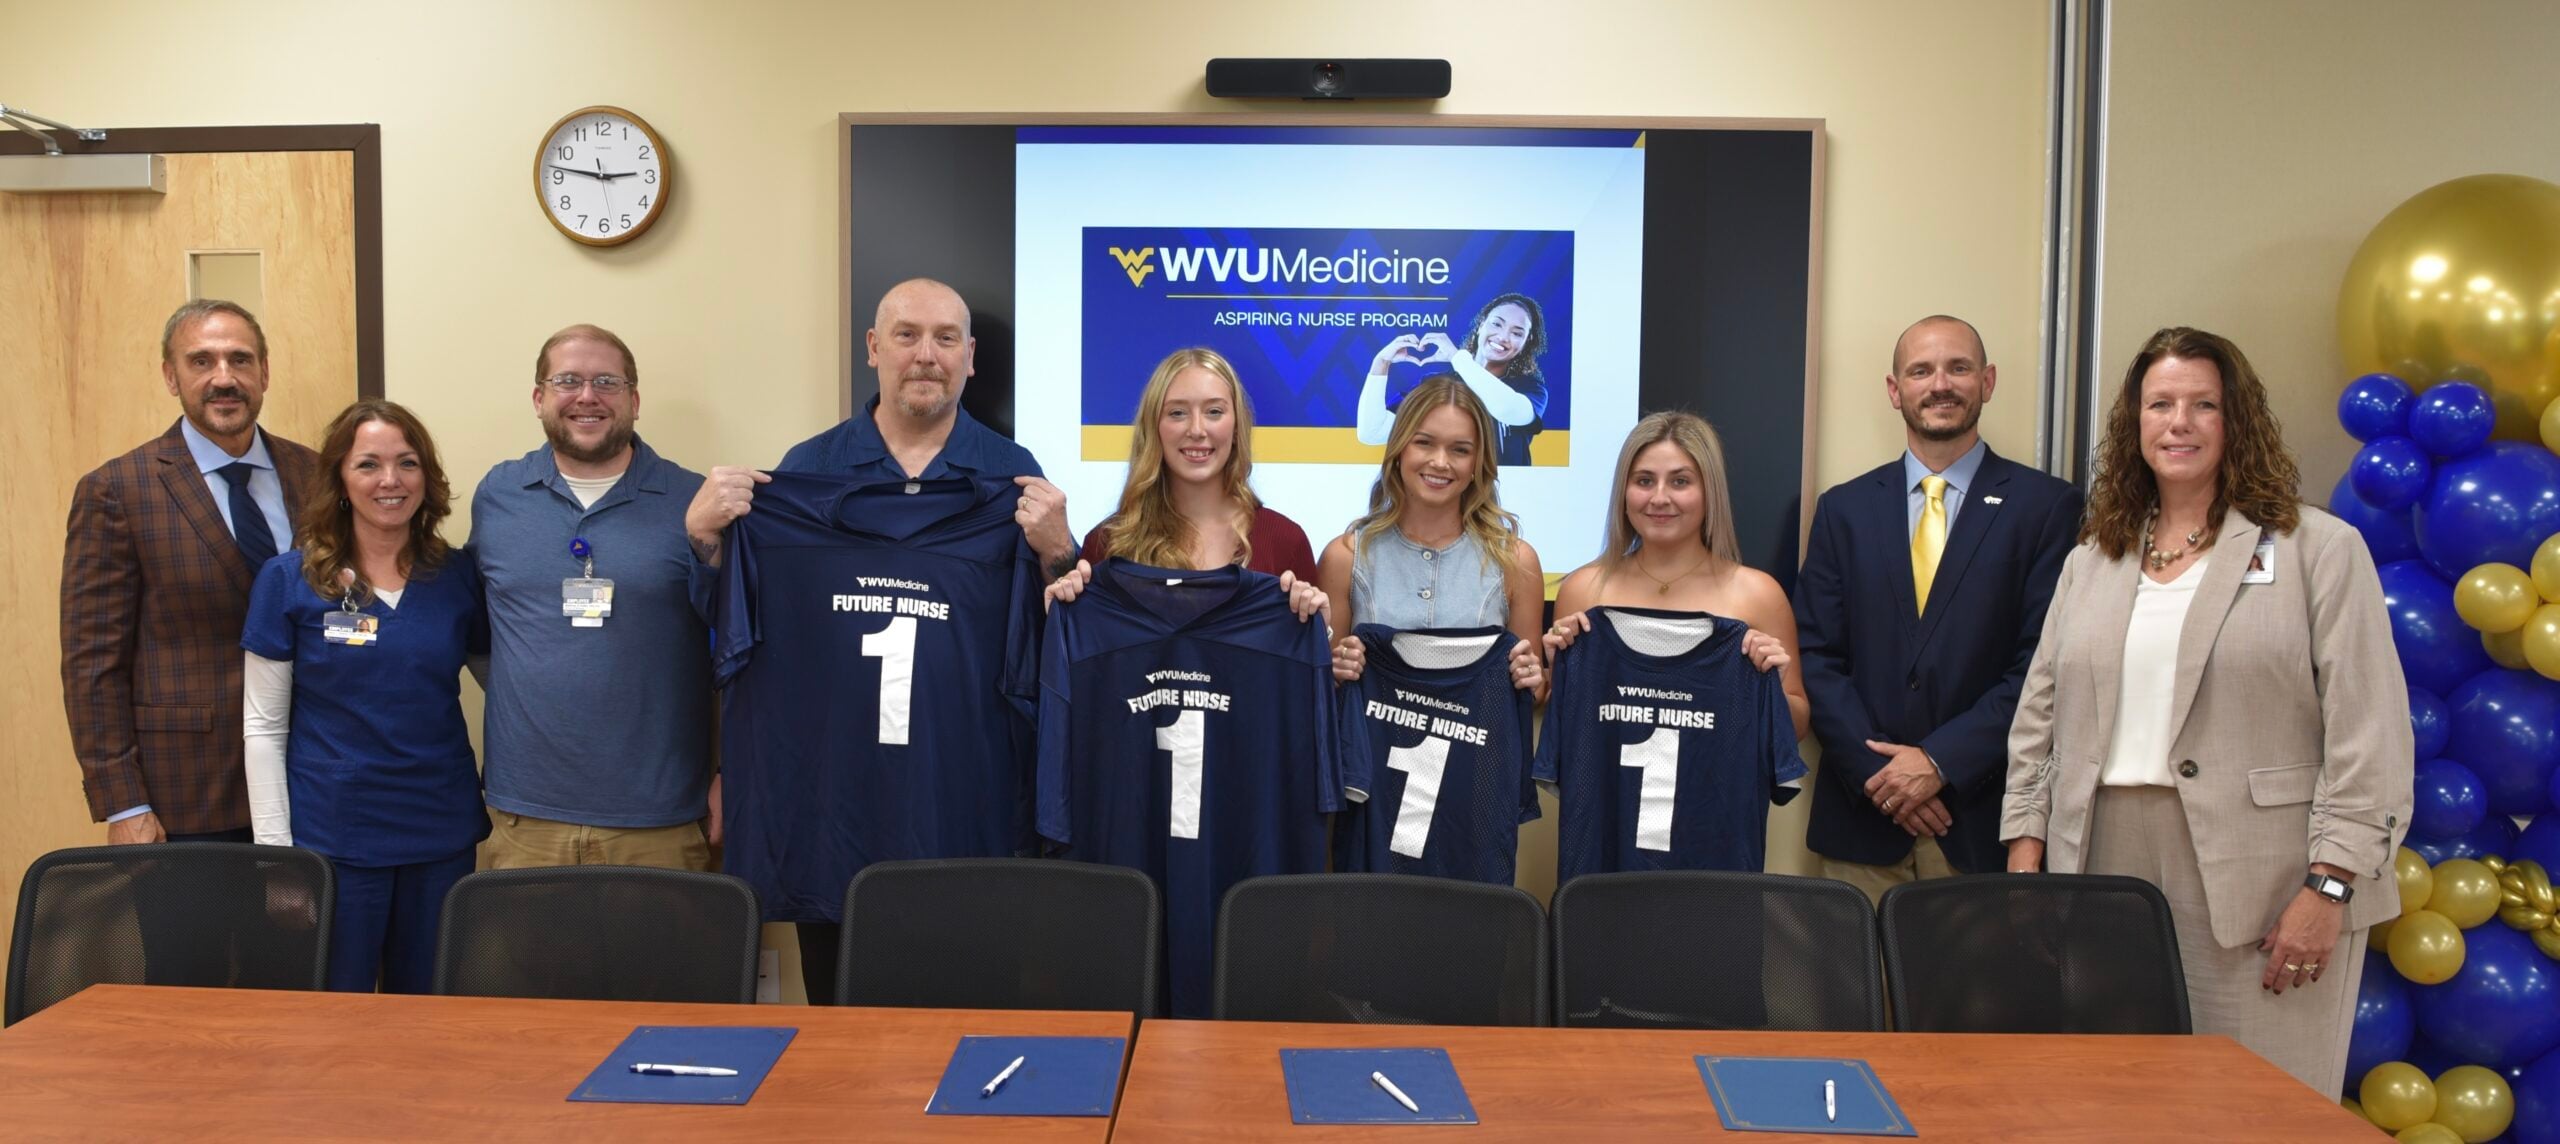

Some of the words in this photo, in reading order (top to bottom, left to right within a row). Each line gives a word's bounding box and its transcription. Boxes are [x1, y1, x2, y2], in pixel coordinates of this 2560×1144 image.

[574, 127, 587, 142] 11
[594, 121, 612, 136] 12
[622, 126, 627, 141] 1
[557, 145, 574, 161] 10
[638, 145, 650, 160] 2
[552, 169, 564, 185] 9
[644, 169, 656, 184] 3
[560, 195, 571, 210] 8
[638, 195, 650, 210] 4
[577, 214, 588, 229] 7
[598, 218, 610, 233] 6
[620, 214, 632, 229] 5
[1159, 247, 1449, 284] WVUMedicine
[1214, 311, 1293, 328] ASPIRING
[1298, 312, 1356, 328] NURSE
[1361, 312, 1448, 328] PROGRAM
[867, 577, 929, 592] WVUMedicine
[832, 594, 893, 613] FUTURE
[896, 597, 950, 620] NURSE
[861, 616, 918, 745] 1
[1155, 670, 1211, 683] WVUMedicine
[1127, 688, 1179, 714] FUTURE
[1183, 690, 1231, 712] NURSE
[1626, 686, 1693, 701] WVUMedicine
[1405, 691, 1470, 715] WVUMedicine
[1365, 699, 1428, 731] FUTURE
[1430, 716, 1488, 746] NURSE
[1599, 704, 1654, 724] FUTURE
[1658, 708, 1715, 729] NURSE
[1155, 709, 1205, 839] 1
[1386, 735, 1451, 859] 1
[1620, 727, 1680, 852] 1
